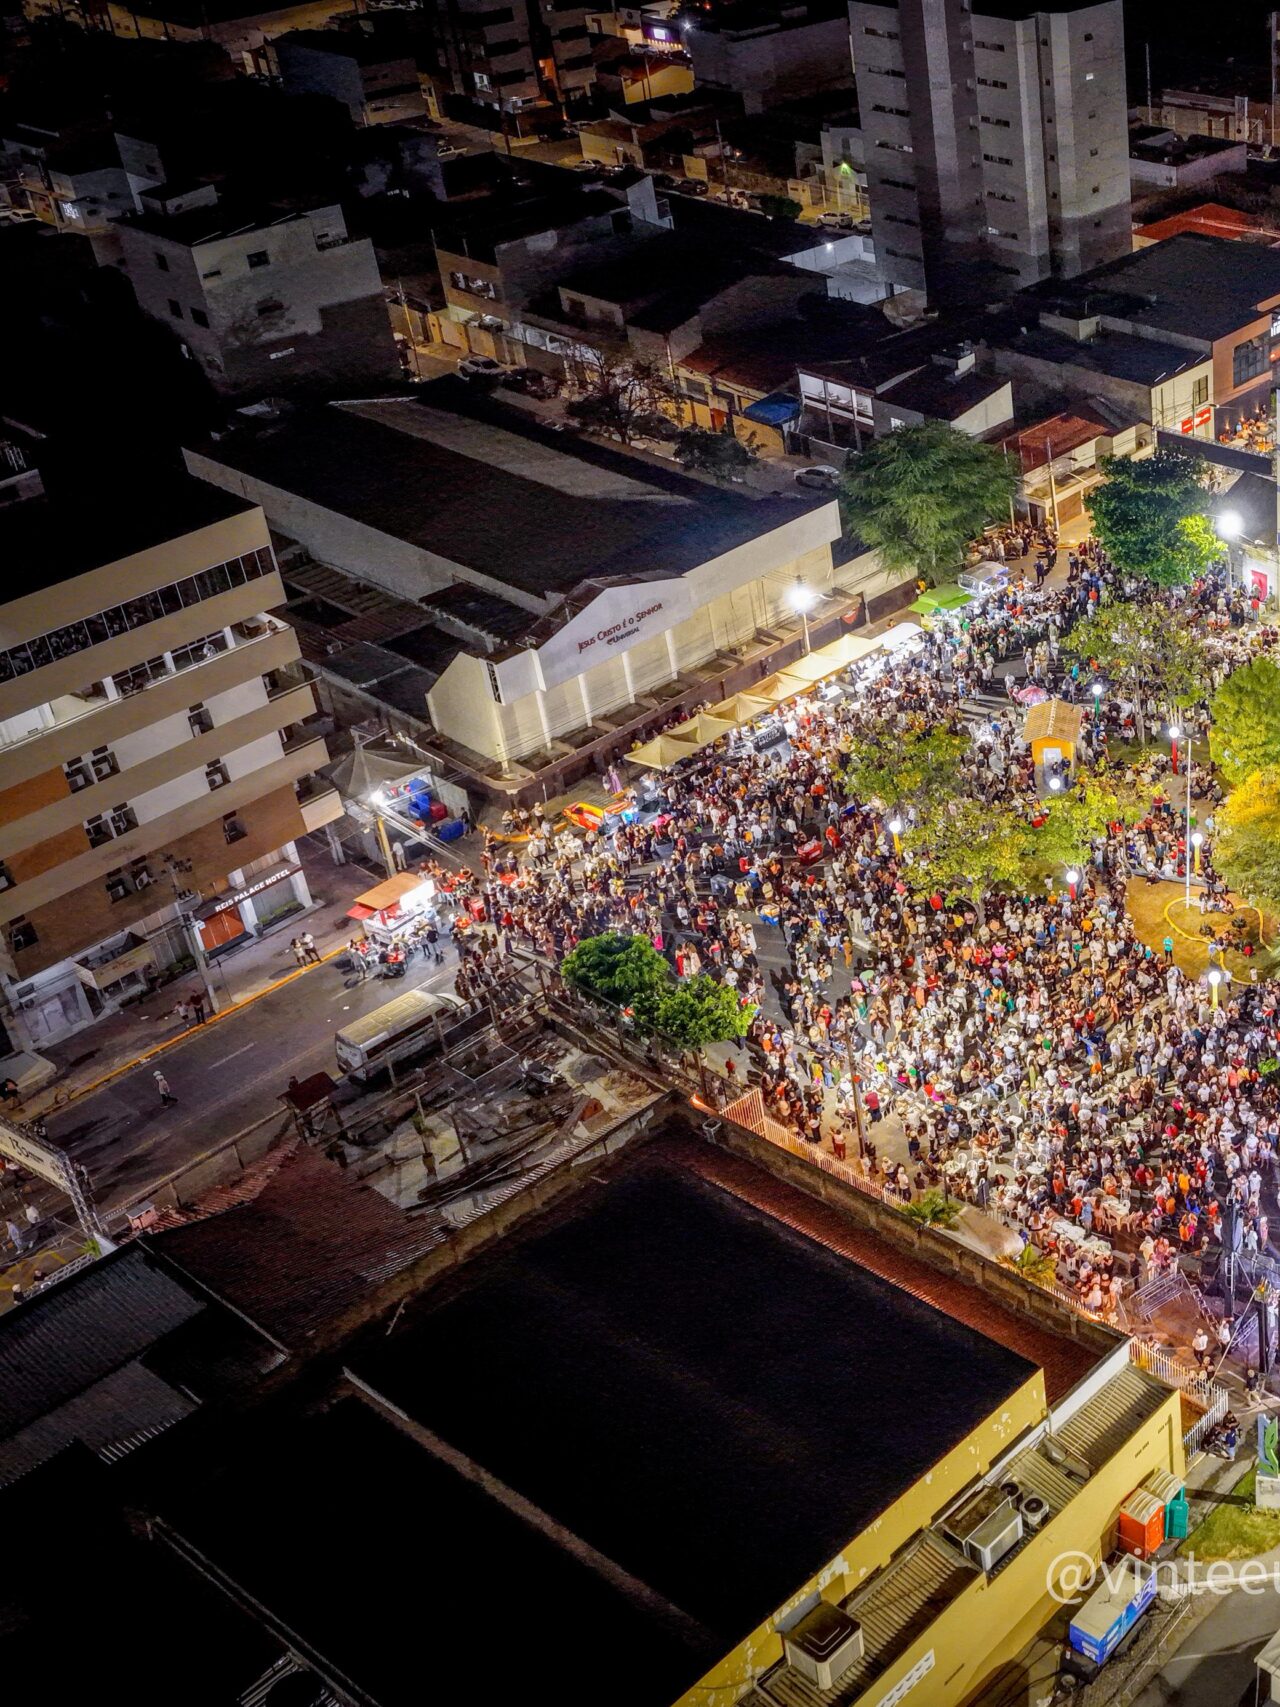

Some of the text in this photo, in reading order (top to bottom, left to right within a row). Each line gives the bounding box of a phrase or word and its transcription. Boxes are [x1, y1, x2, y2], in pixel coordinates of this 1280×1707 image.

[578, 636, 596, 654] JESUS
[597, 623, 622, 641] CRISTO
[635, 602, 663, 622] SENHOR
[214, 869, 291, 913] REIS PALACE HOTEL
